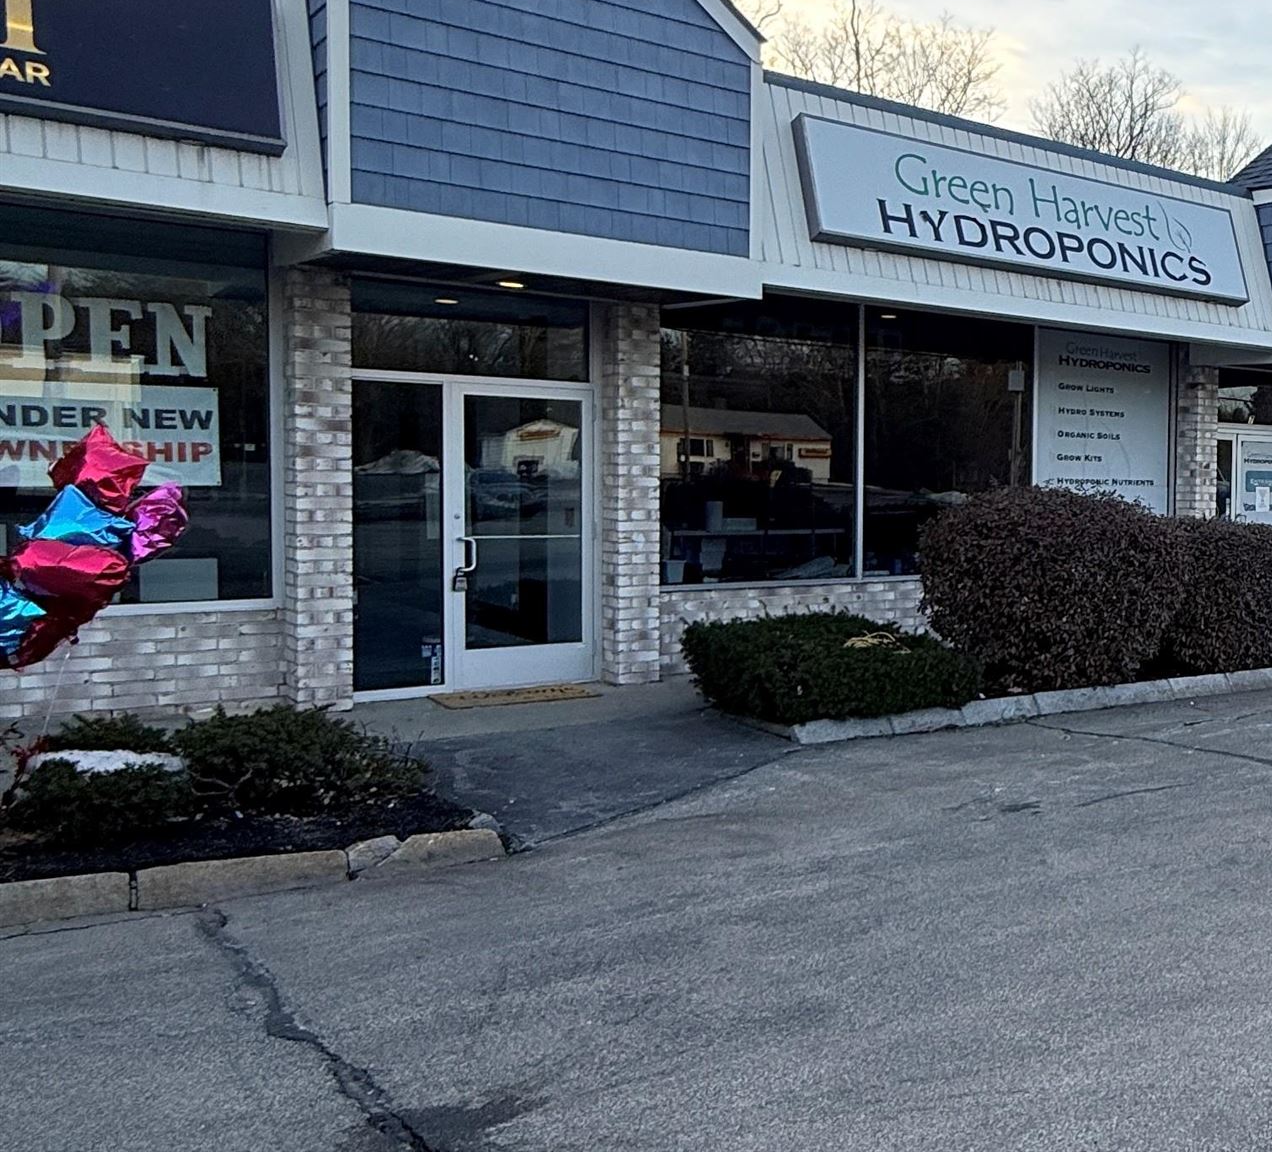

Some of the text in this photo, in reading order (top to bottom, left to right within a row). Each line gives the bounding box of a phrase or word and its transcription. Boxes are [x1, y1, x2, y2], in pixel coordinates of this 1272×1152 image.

[894, 153, 1160, 241] Green Harvest
[876, 198, 1212, 286] HYDROPONICS
[0, 293, 212, 377] PEN
[1058, 354, 1151, 374] HYDROPONICS
[124, 408, 213, 430] NEW
